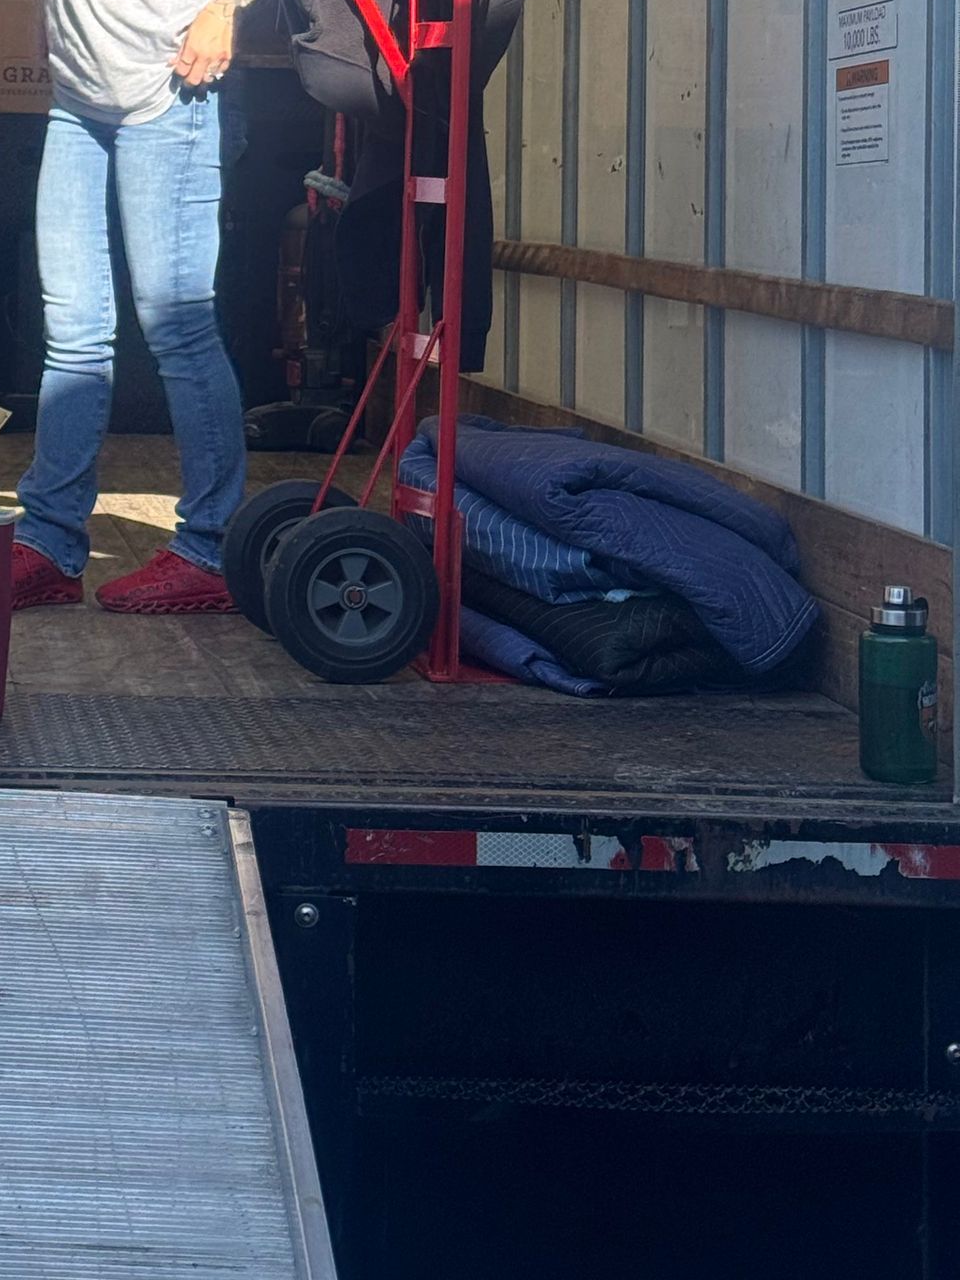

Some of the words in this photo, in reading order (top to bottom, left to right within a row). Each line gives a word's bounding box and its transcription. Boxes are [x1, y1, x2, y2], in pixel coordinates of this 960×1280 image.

[838, 10, 863, 29] MAXIMUM
[863, 5, 886, 24] PAYLOAD
[843, 27, 865, 53] 10,000
[851, 66, 879, 85] WARNING
